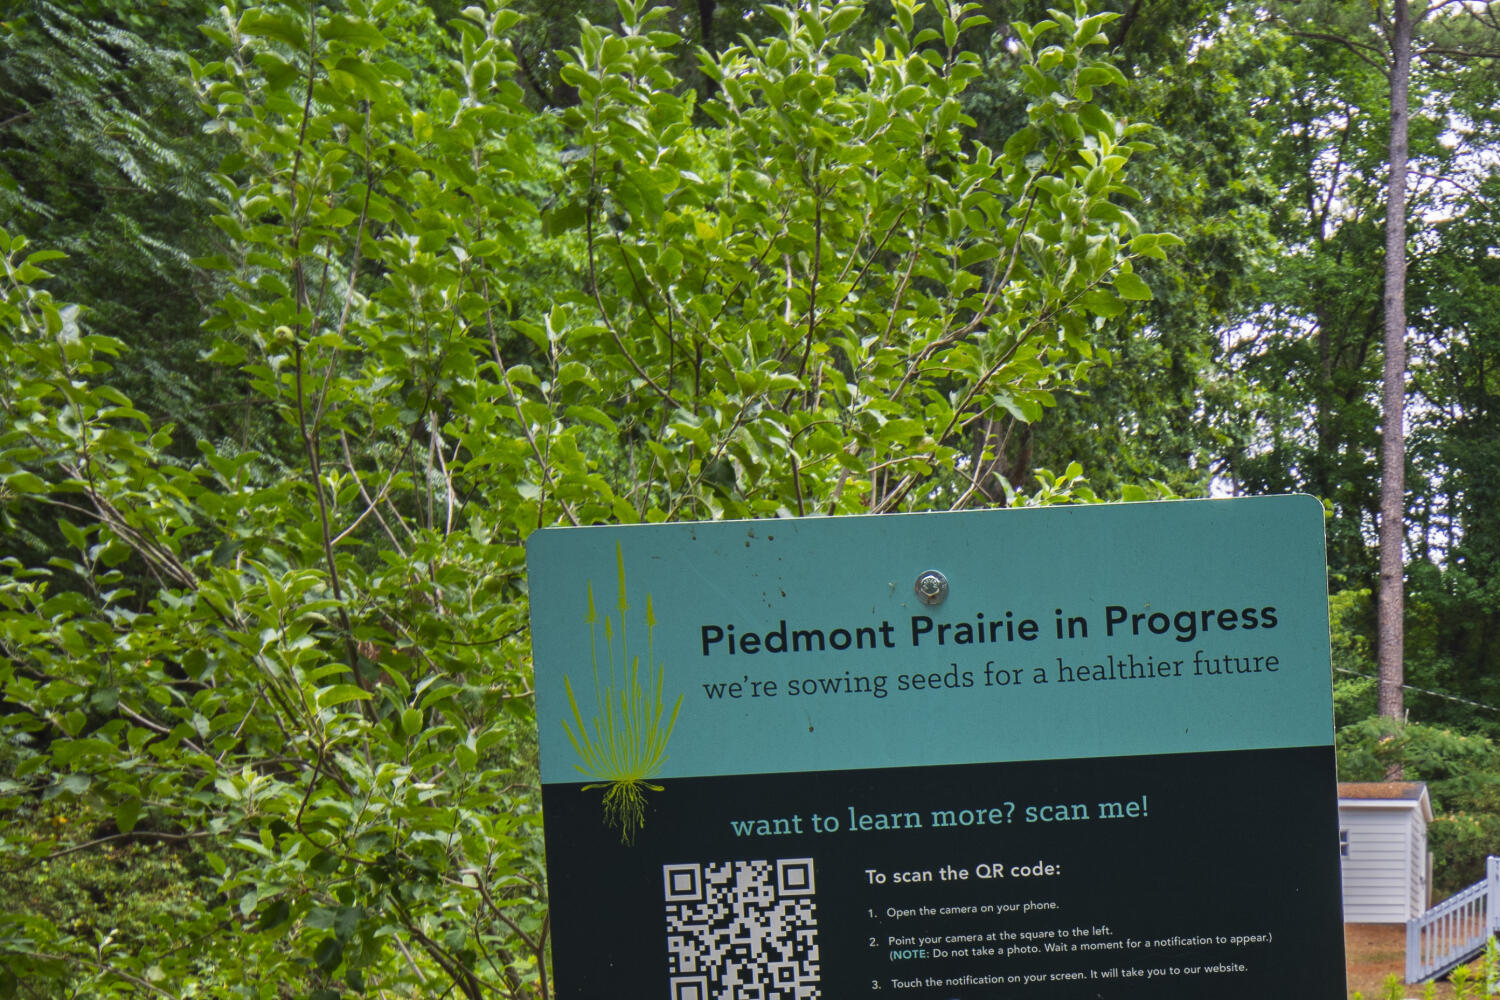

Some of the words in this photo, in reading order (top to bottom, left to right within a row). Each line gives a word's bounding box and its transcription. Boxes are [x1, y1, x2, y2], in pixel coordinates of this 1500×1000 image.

[701, 619, 895, 657] Piedmont
[911, 610, 1039, 647] Prairie
[1055, 608, 1088, 640] in
[1105, 605, 1278, 643] Progress
[702, 675, 778, 700] we're
[788, 670, 888, 699] sowing
[897, 662, 974, 691] seeds
[983, 660, 1024, 687] for
[1033, 667, 1049, 685] a
[1056, 654, 1184, 683] healthier
[1192, 649, 1280, 676] future
[730, 814, 804, 837] want
[811, 813, 840, 833] to
[847, 806, 923, 832] learn
[930, 801, 1015, 828] more?
[1025, 803, 1090, 823] scan
[1098, 794, 1148, 819] me!
[864, 869, 887, 885] To
[892, 870, 933, 884] scan
[938, 864, 969, 881] the
[975, 863, 1004, 879] QR
[1010, 860, 1061, 878] code:
[868, 908, 878, 918] 1.
[886, 907, 917, 920] Open
[918, 905, 937, 916] the
[939, 905, 978, 915] camera
[980, 905, 994, 913] on
[996, 903, 1021, 915] your
[1022, 900, 1060, 914] phone.
[869, 936, 879, 947] 2.
[888, 935, 916, 946] Point
[918, 936, 943, 947] your
[944, 934, 983, 944] camera
[985, 932, 997, 941] at
[998, 930, 1017, 941] the
[1019, 930, 1055, 942] square
[1057, 928, 1070, 938] to
[1071, 926, 1090, 937] the
[1092, 924, 1113, 936] left.
[889, 949, 930, 962] (NOTE:
[932, 948, 949, 958] Do
[951, 948, 969, 957] not
[971, 945, 995, 957] take
[997, 947, 1004, 955] a
[1006, 944, 1042, 958] photo.
[1043, 942, 1068, 953] Wait
[1070, 943, 1078, 952] a
[1080, 940, 1124, 951] moment
[1126, 938, 1142, 949] for
[1144, 940, 1151, 948] a
[1153, 935, 1213, 947] notification
[1215, 935, 1227, 945] to
[1230, 932, 1273, 947] appear.)
[871, 979, 882, 990] 3.
[890, 977, 923, 989] Touch
[924, 976, 943, 987] the
[945, 974, 1005, 986] notification
[1007, 975, 1021, 983] on
[1023, 973, 1048, 985] your
[1049, 972, 1088, 981] screen.
[1090, 969, 1098, 979] It
[1100, 967, 1119, 979] will
[1120, 967, 1145, 978] take
[1146, 968, 1167, 979] you
[1168, 966, 1181, 975] to
[1183, 966, 1202, 975] our
[1203, 962, 1248, 974] website.
